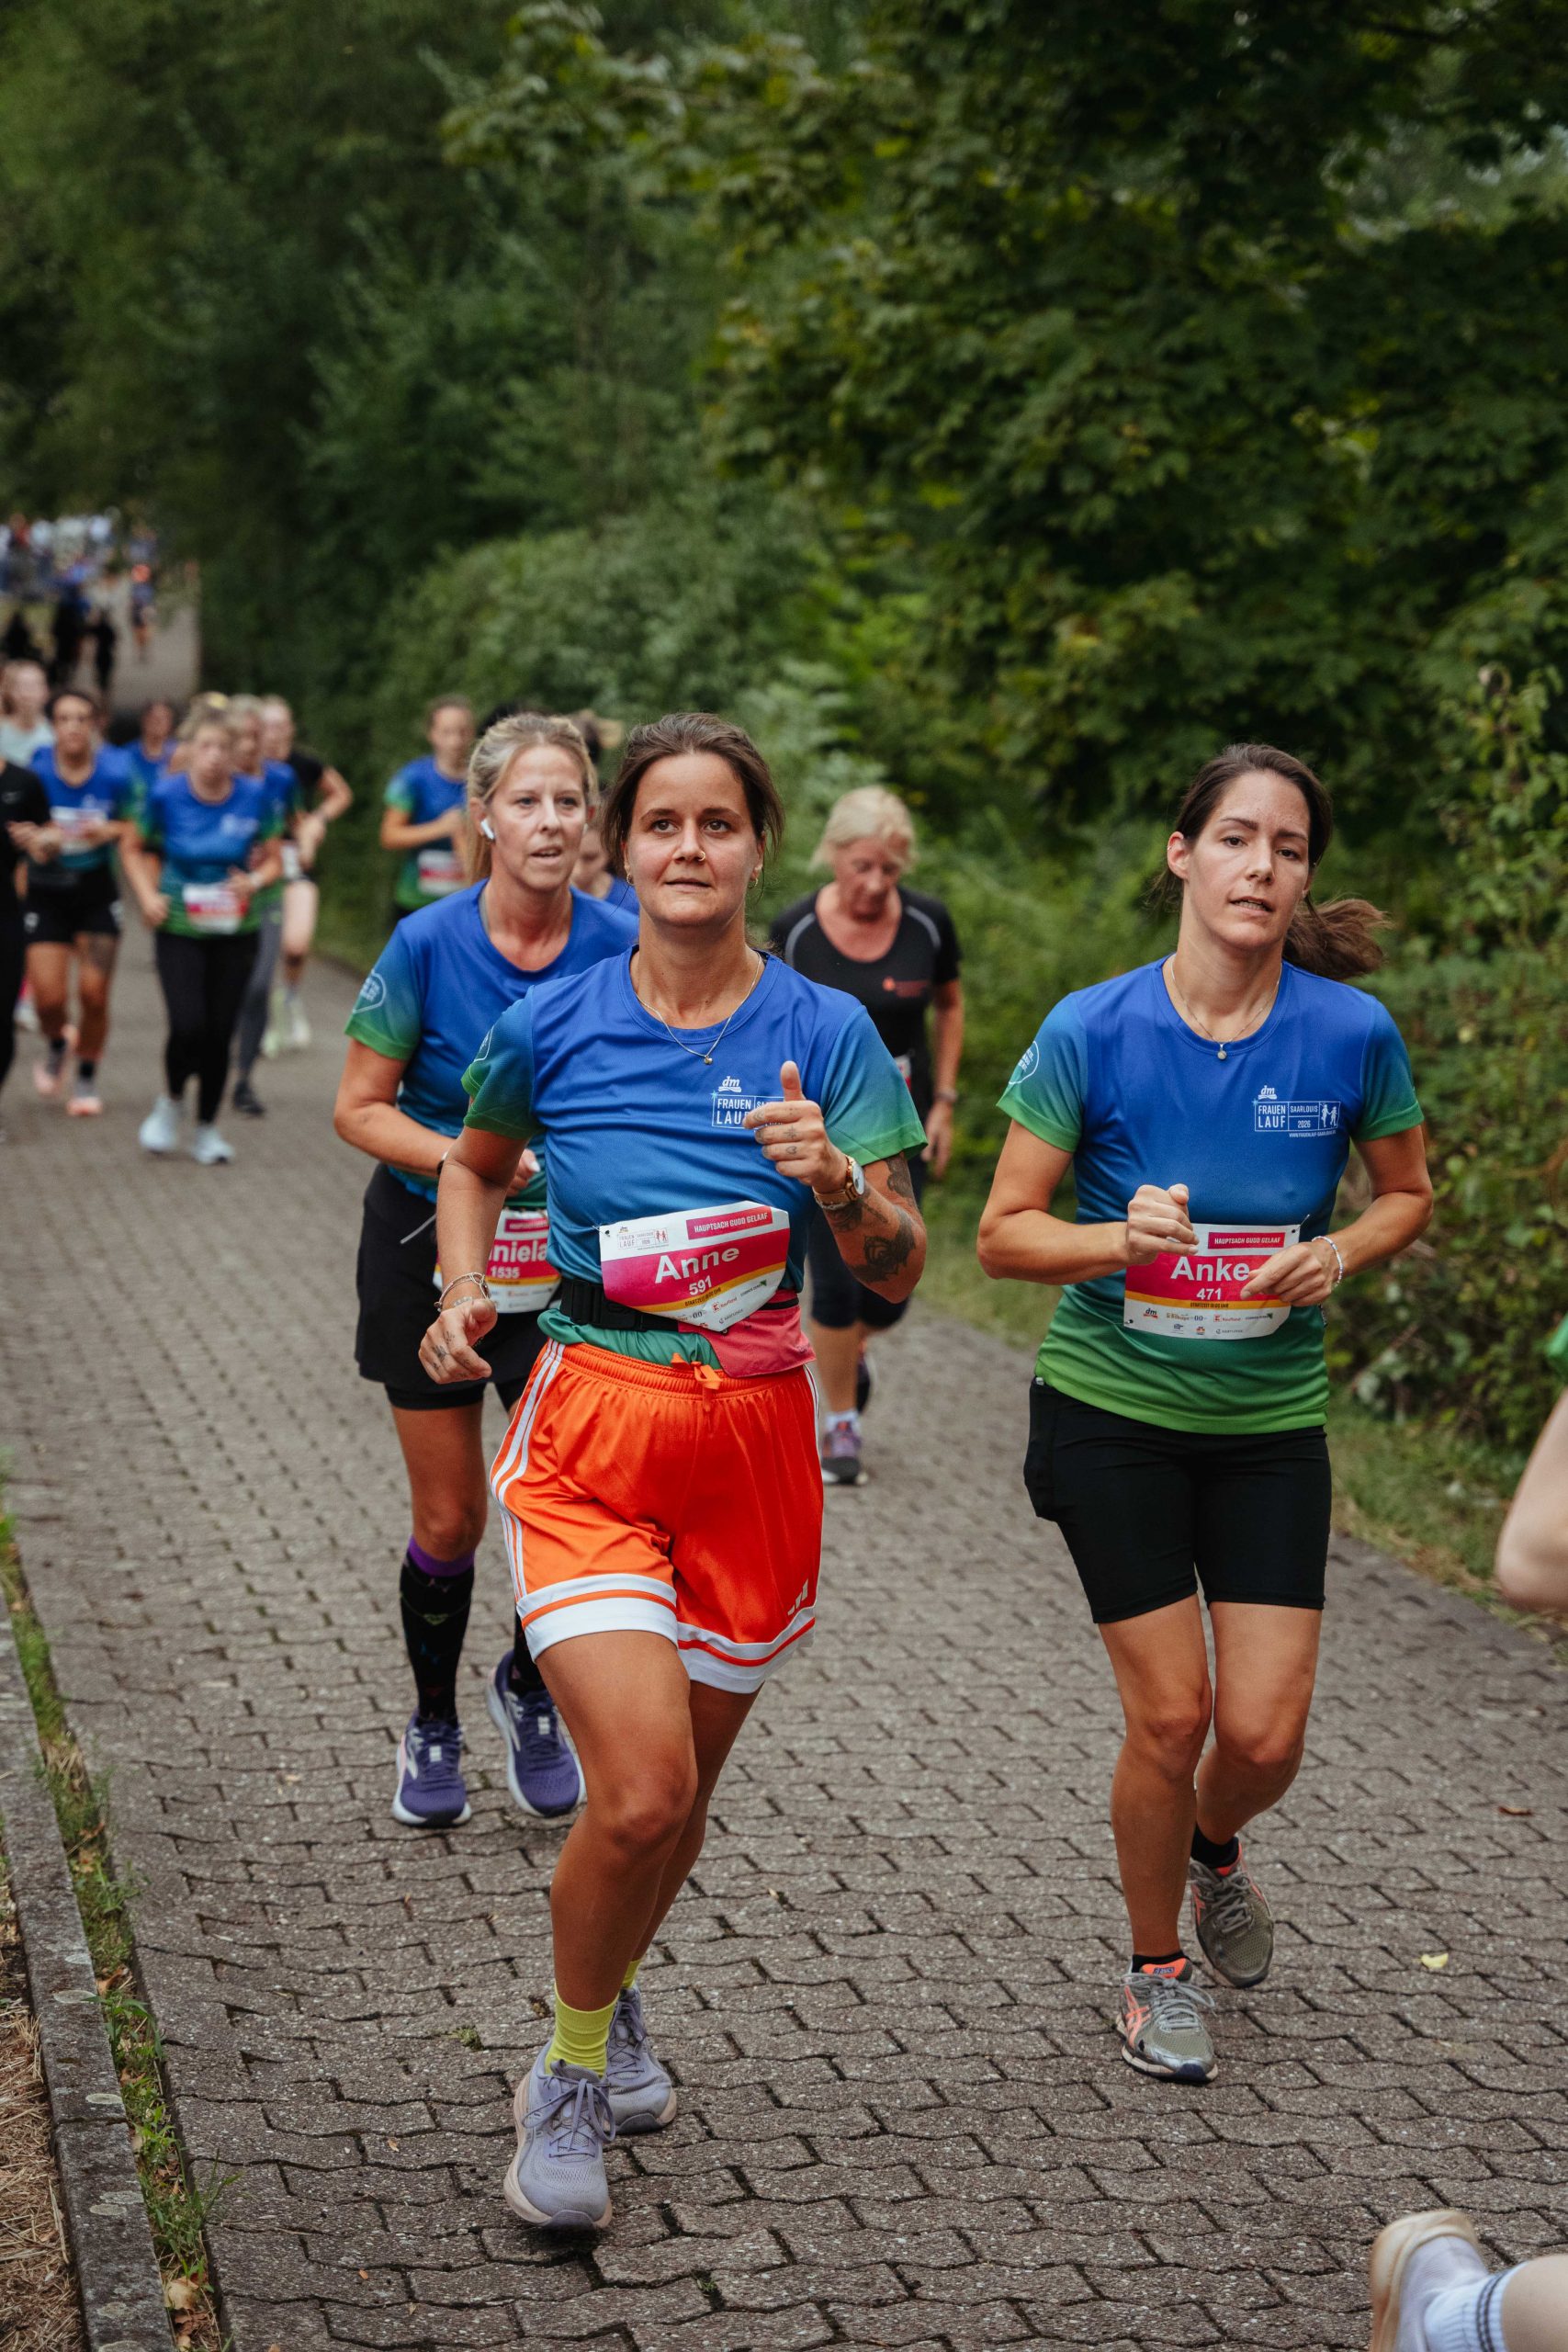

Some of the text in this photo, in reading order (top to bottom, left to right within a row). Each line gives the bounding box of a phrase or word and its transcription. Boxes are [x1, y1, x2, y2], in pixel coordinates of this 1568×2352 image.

[722, 1075, 740, 1087] dm
[1260, 1084, 1275, 1095] dm
[717, 1098, 751, 1110] FRAUEN
[1258, 1104, 1286, 1114] FRAUEN
[1290, 1105, 1318, 1114] SAARLOUIS
[1258, 1115, 1286, 1128] LAUF
[694, 1220, 729, 1233] HAUPTSACH
[746, 1212, 768, 1223] GELAAF
[654, 1247, 740, 1284] Anne
[1169, 1256, 1250, 1282] Anke
[491, 1265, 520, 1279] 1535
[689, 1275, 712, 1296] 591
[1196, 1288, 1221, 1300] 471
[1145, 1307, 1157, 1316] dm
